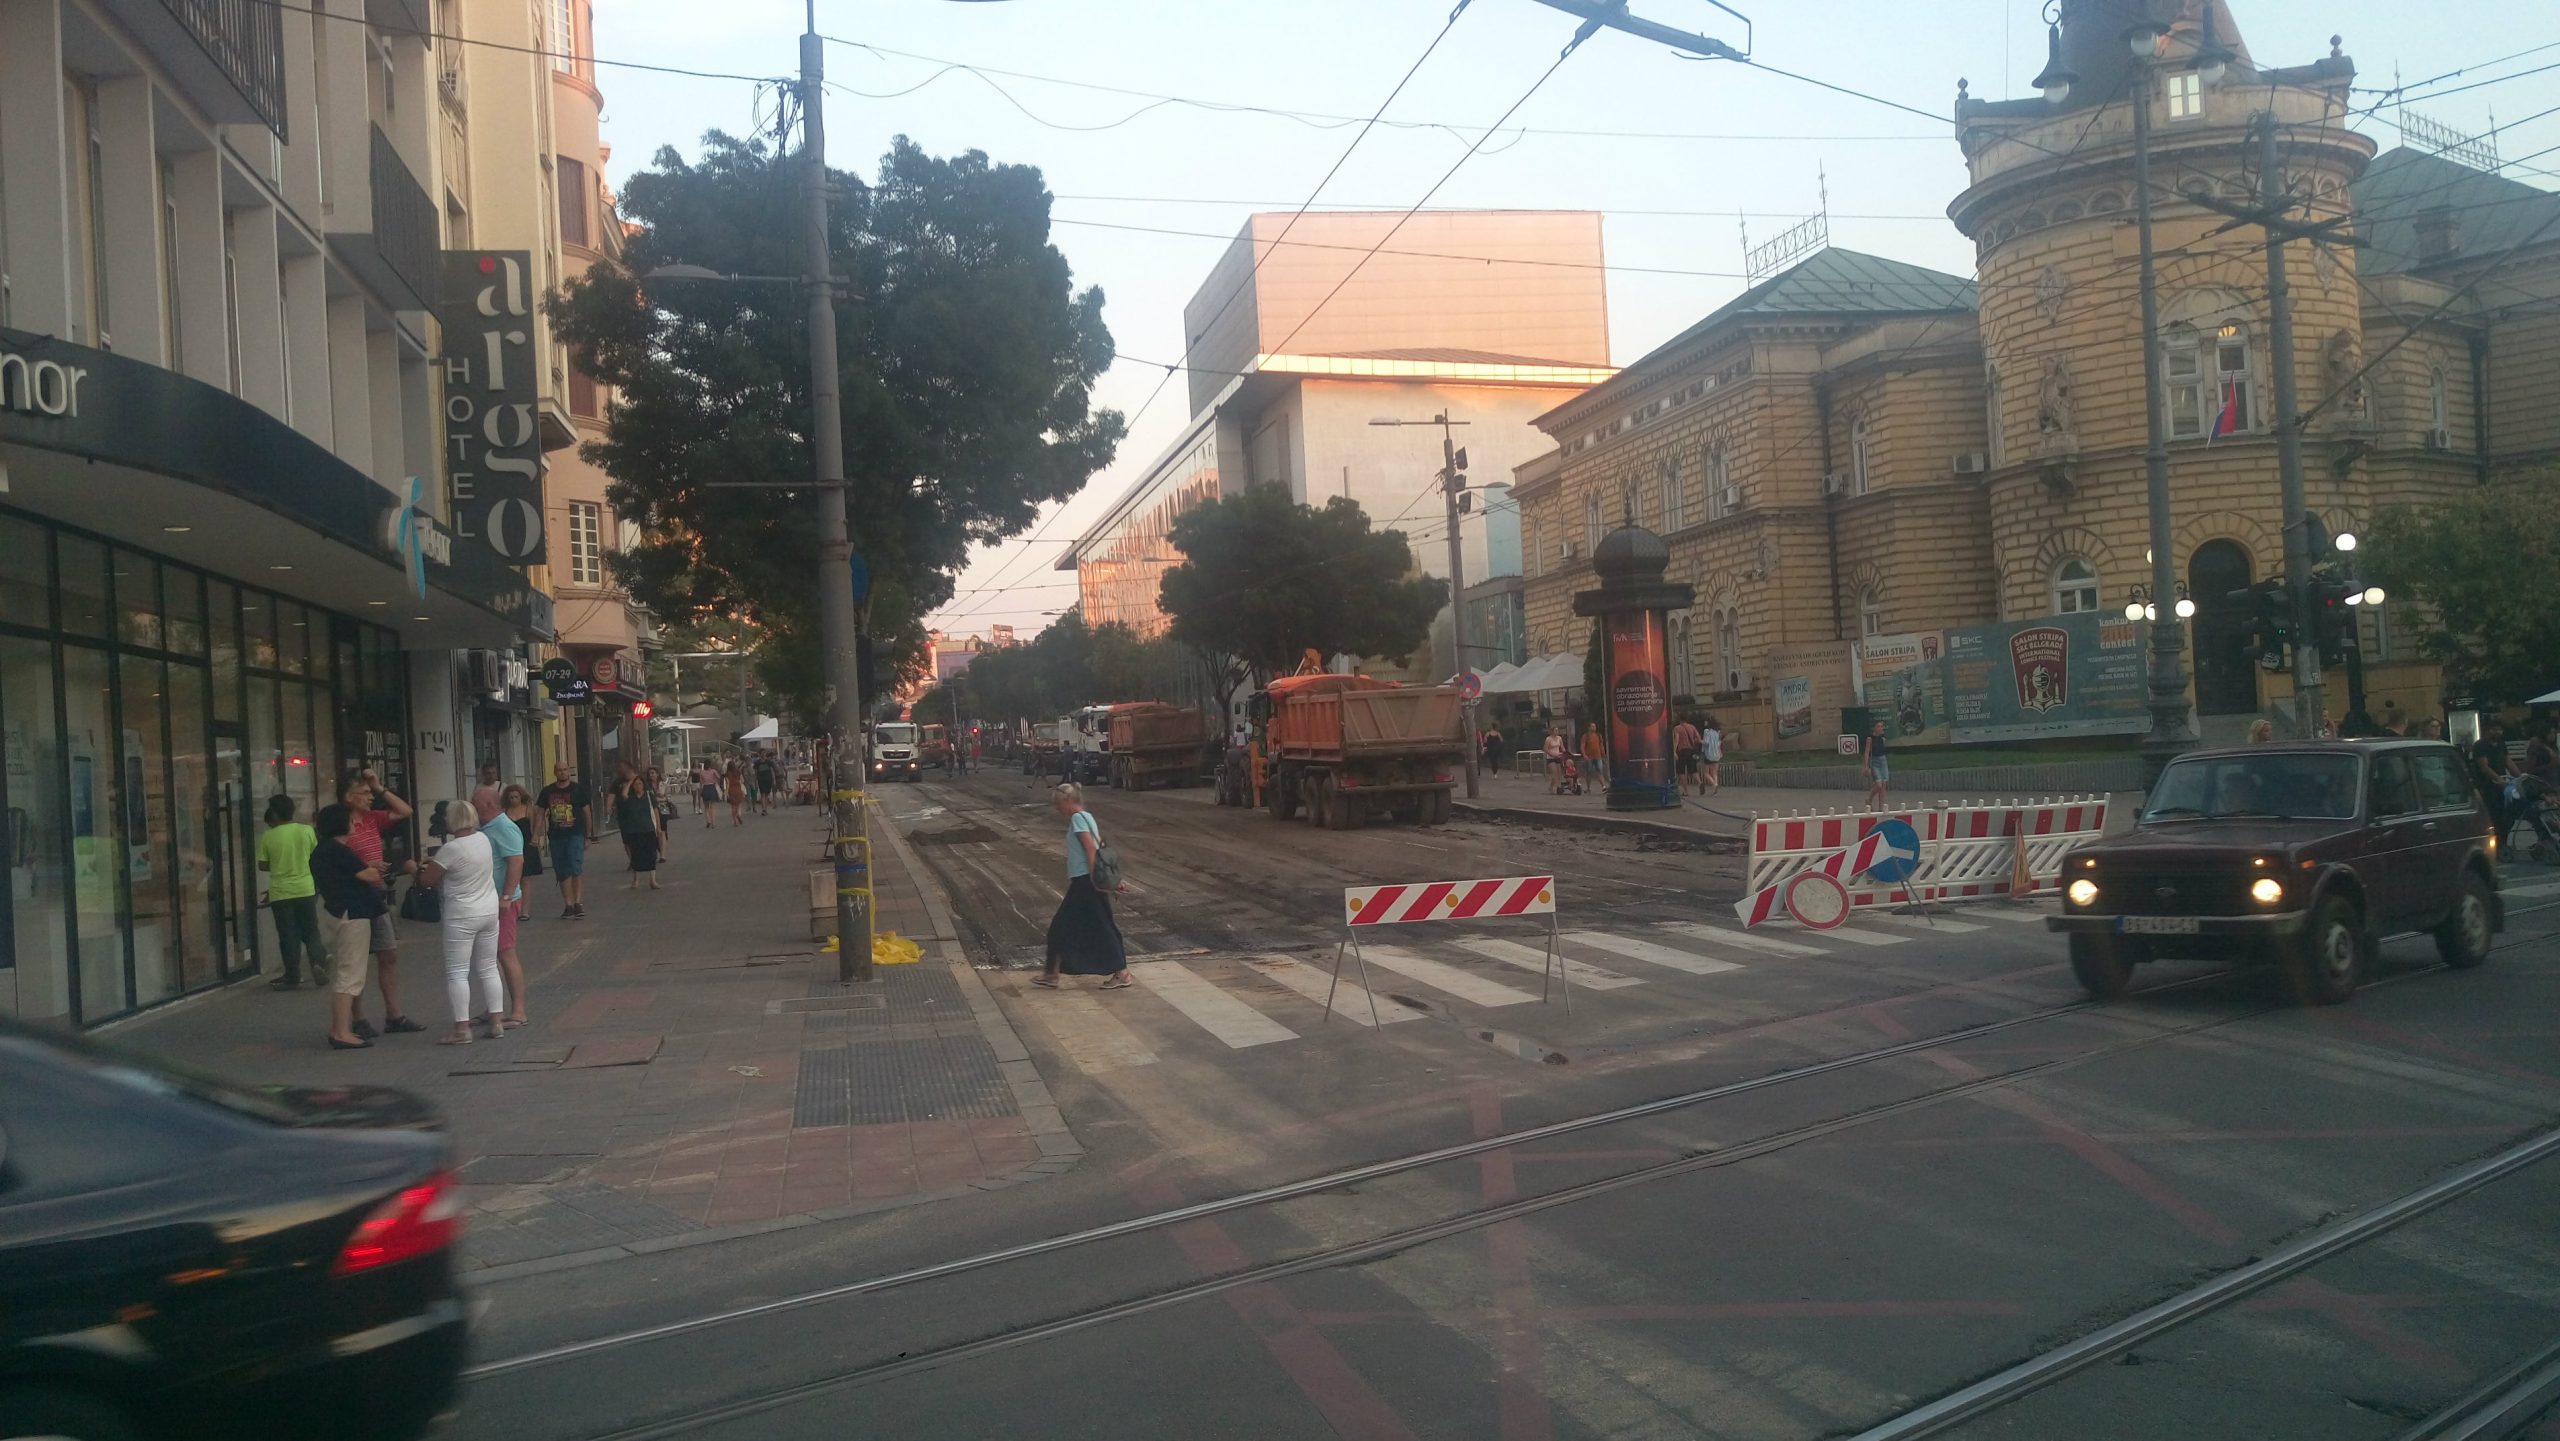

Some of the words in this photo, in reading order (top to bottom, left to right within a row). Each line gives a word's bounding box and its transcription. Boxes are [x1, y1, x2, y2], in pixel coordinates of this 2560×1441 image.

[477, 257, 542, 558] argo
[447, 357, 476, 538] HOTEL
[1961, 635, 1983, 645] SKC
[2014, 633, 2038, 646] SALON
[2039, 632, 2064, 643] STRIPA
[2029, 640, 2064, 650] BELGRADE
[1865, 648, 1889, 658] SALON
[1890, 646, 1916, 656] STRIPA
[634, 703, 651, 717] illy
